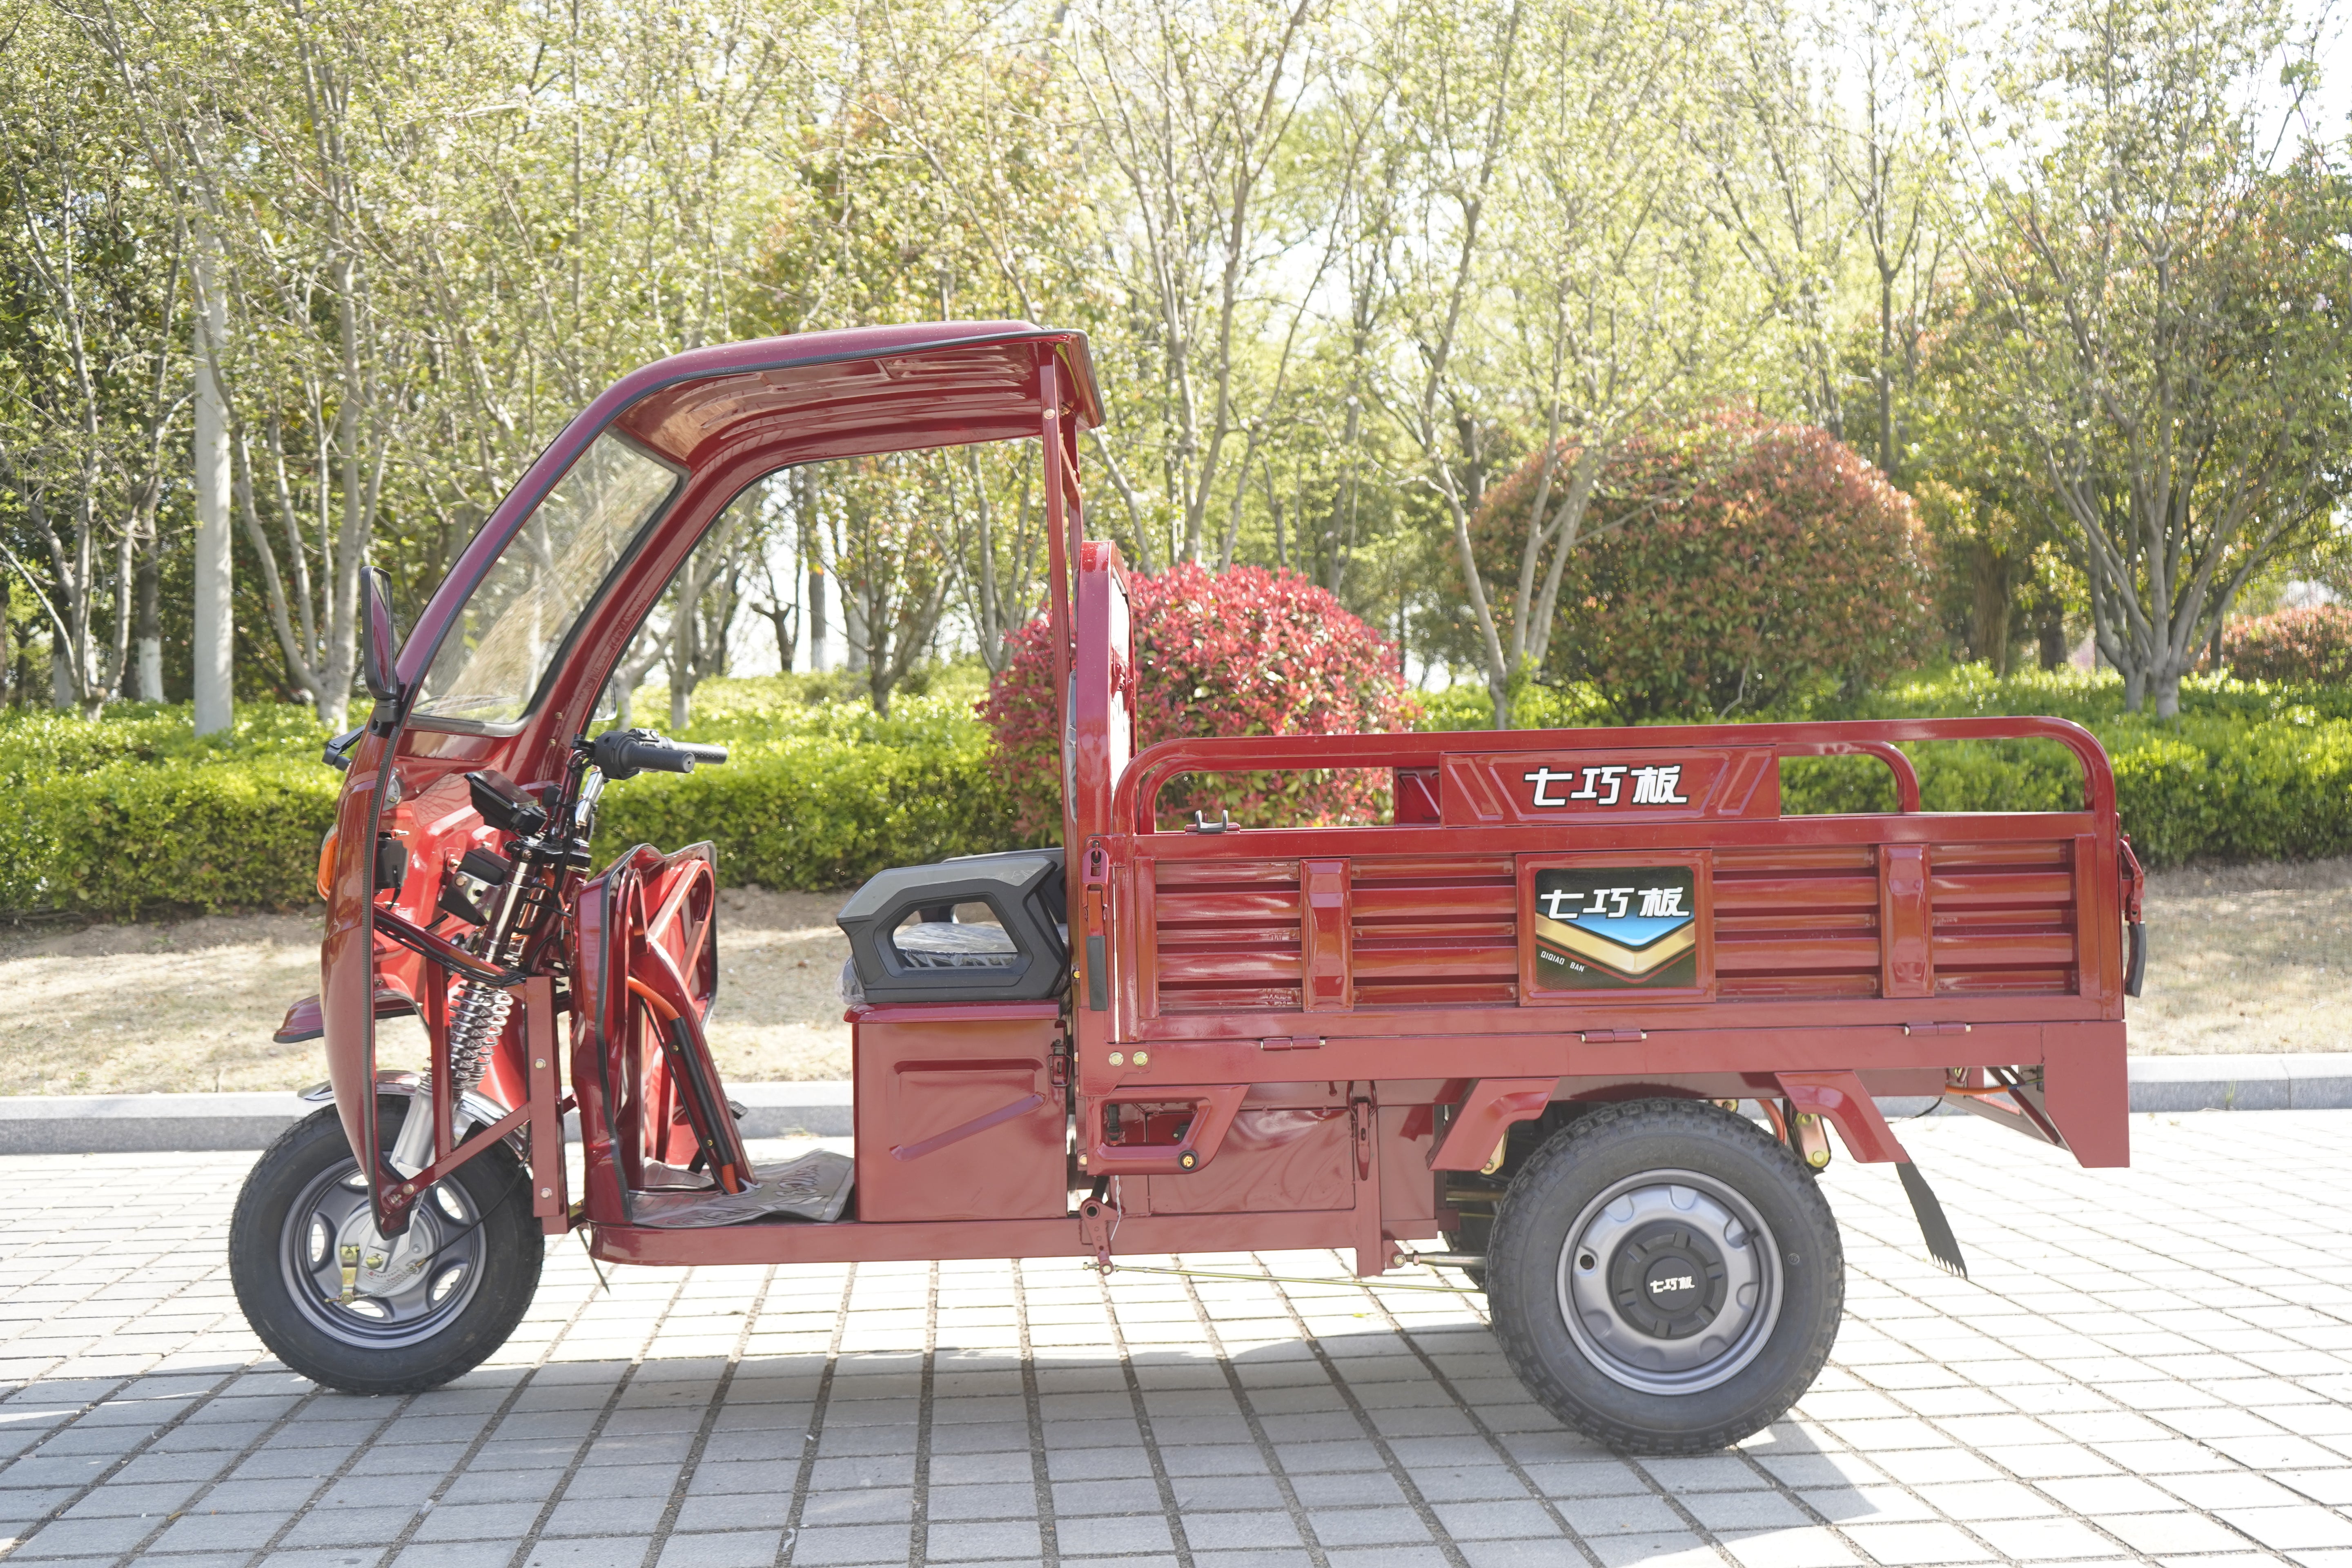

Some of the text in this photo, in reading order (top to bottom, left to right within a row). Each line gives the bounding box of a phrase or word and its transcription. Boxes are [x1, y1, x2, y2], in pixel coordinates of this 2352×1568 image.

[1524, 765, 1688, 806] 七巧板
[1541, 887, 1690, 919] 七巧板
[1541, 951, 1585, 973] QIQIAO BAN
[1650, 1276, 1695, 1294] 七巧板
